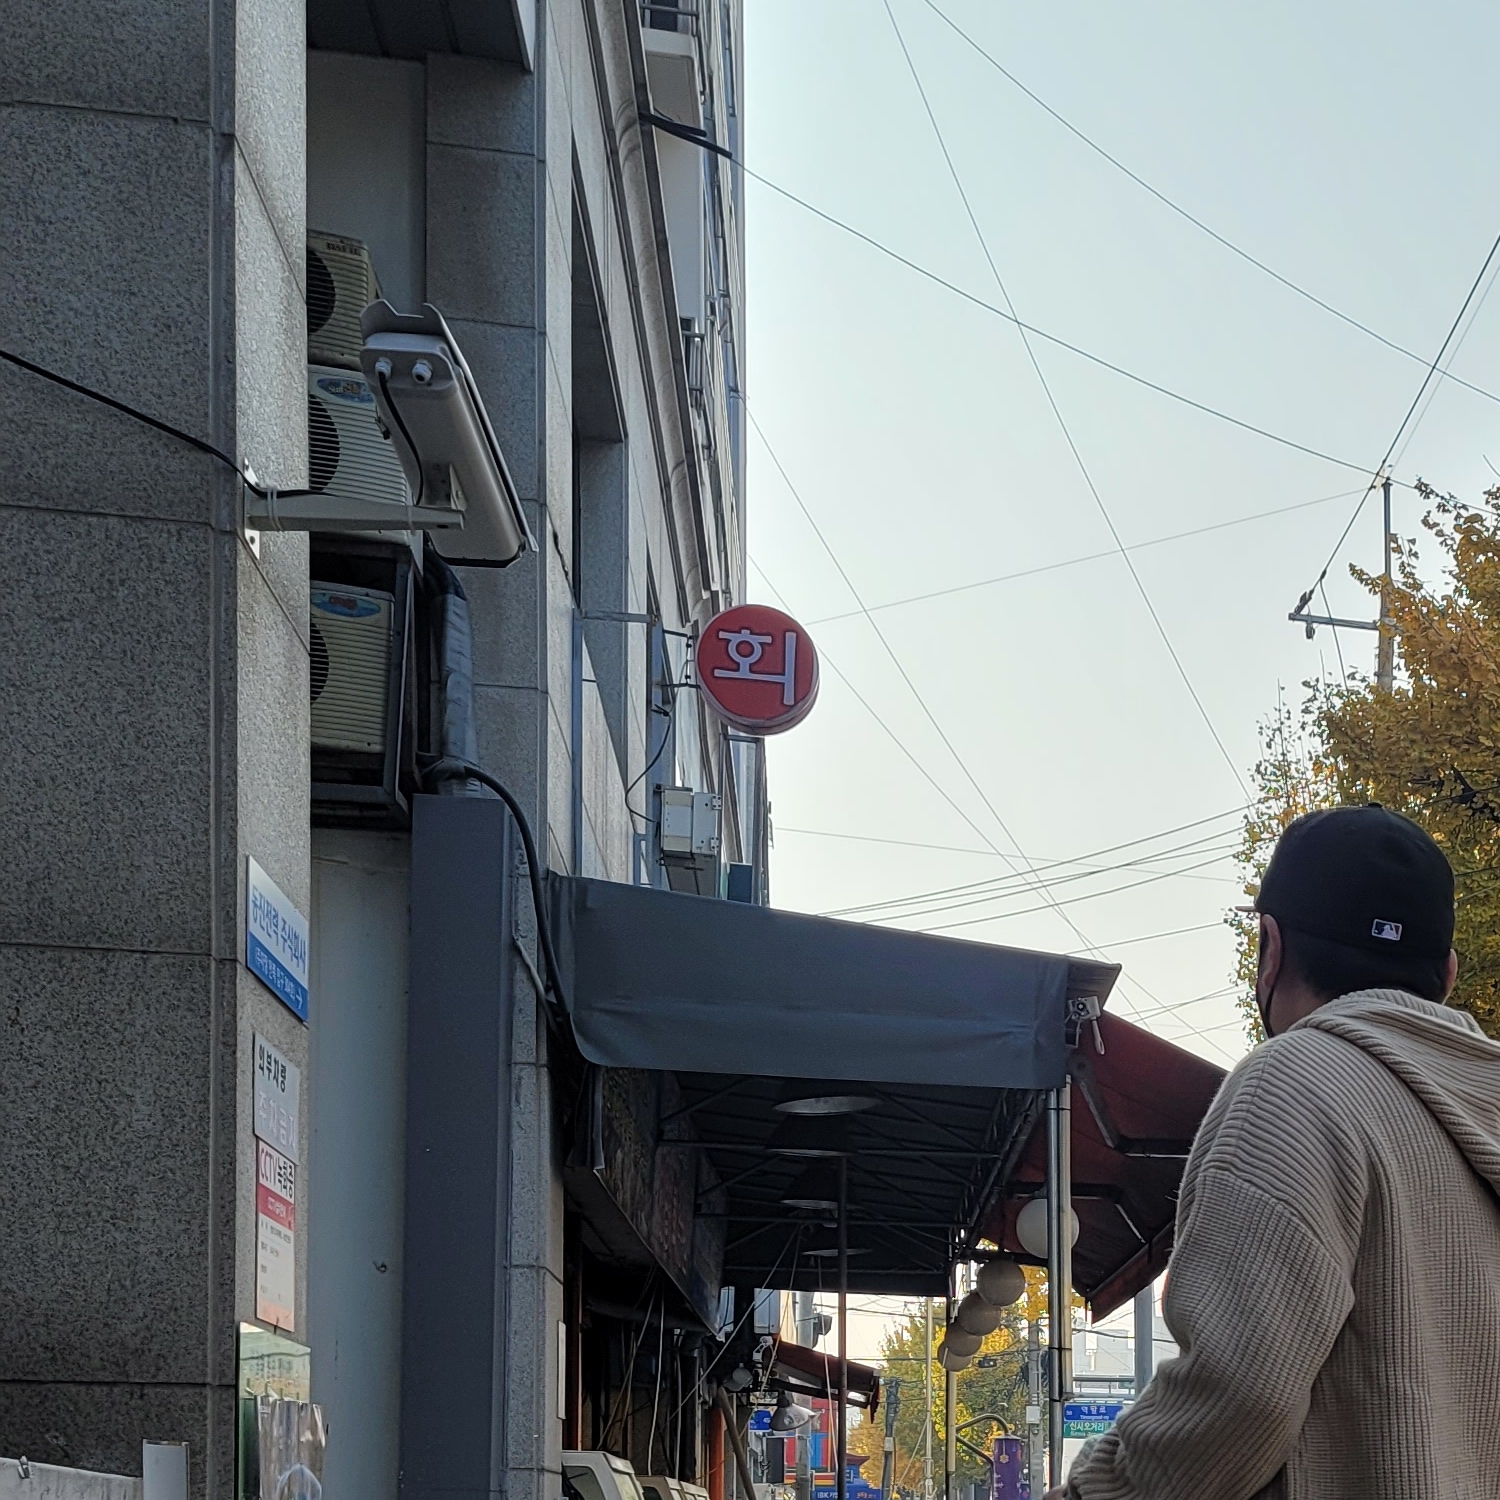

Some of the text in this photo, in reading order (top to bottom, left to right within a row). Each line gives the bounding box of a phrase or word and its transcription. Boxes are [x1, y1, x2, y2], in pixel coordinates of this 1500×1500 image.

[714, 630, 796, 705] 회
[252, 884, 279, 947] 동진전력
[281, 917, 306, 975] 주식회사
[258, 1043, 287, 1094] 외부차량
